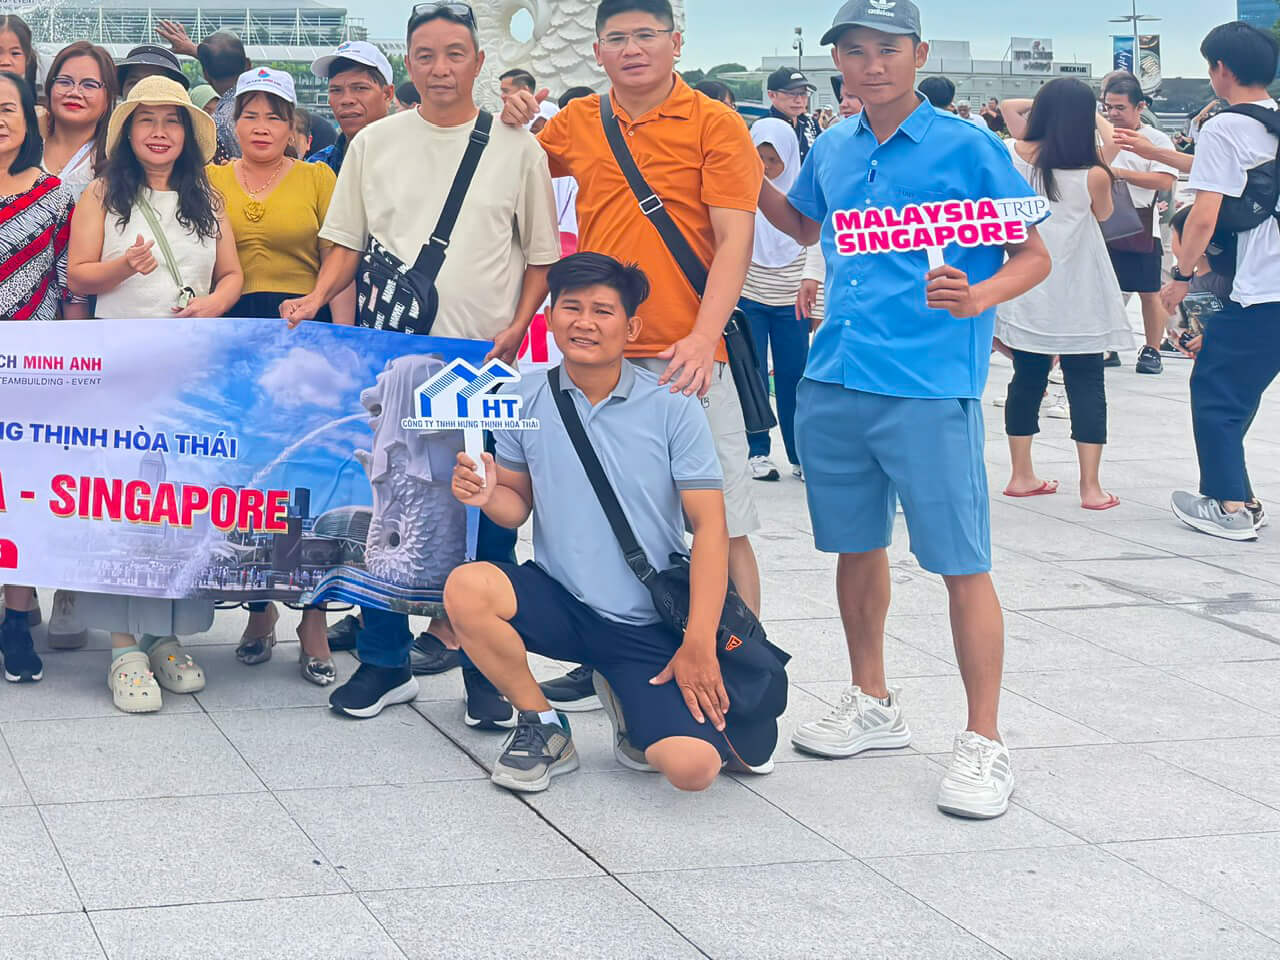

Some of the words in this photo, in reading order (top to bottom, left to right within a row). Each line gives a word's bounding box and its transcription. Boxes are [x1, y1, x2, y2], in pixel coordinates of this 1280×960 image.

[835, 200, 999, 231] MALAYSIA
[998, 200, 1046, 218] TRIP
[838, 221, 1025, 253] SINGAPORE
[23, 356, 64, 370] MINH
[69, 356, 101, 371] ANH
[71, 378, 101, 386] EVENT
[482, 399, 518, 418] HT
[425, 420, 434, 428] TY
[436, 420, 456, 428] TNHH
[29, 423, 108, 450] THỊNH
[113, 425, 169, 453] HÒA
[175, 431, 238, 459] THÁI
[48, 474, 290, 534] SINGAPORE
